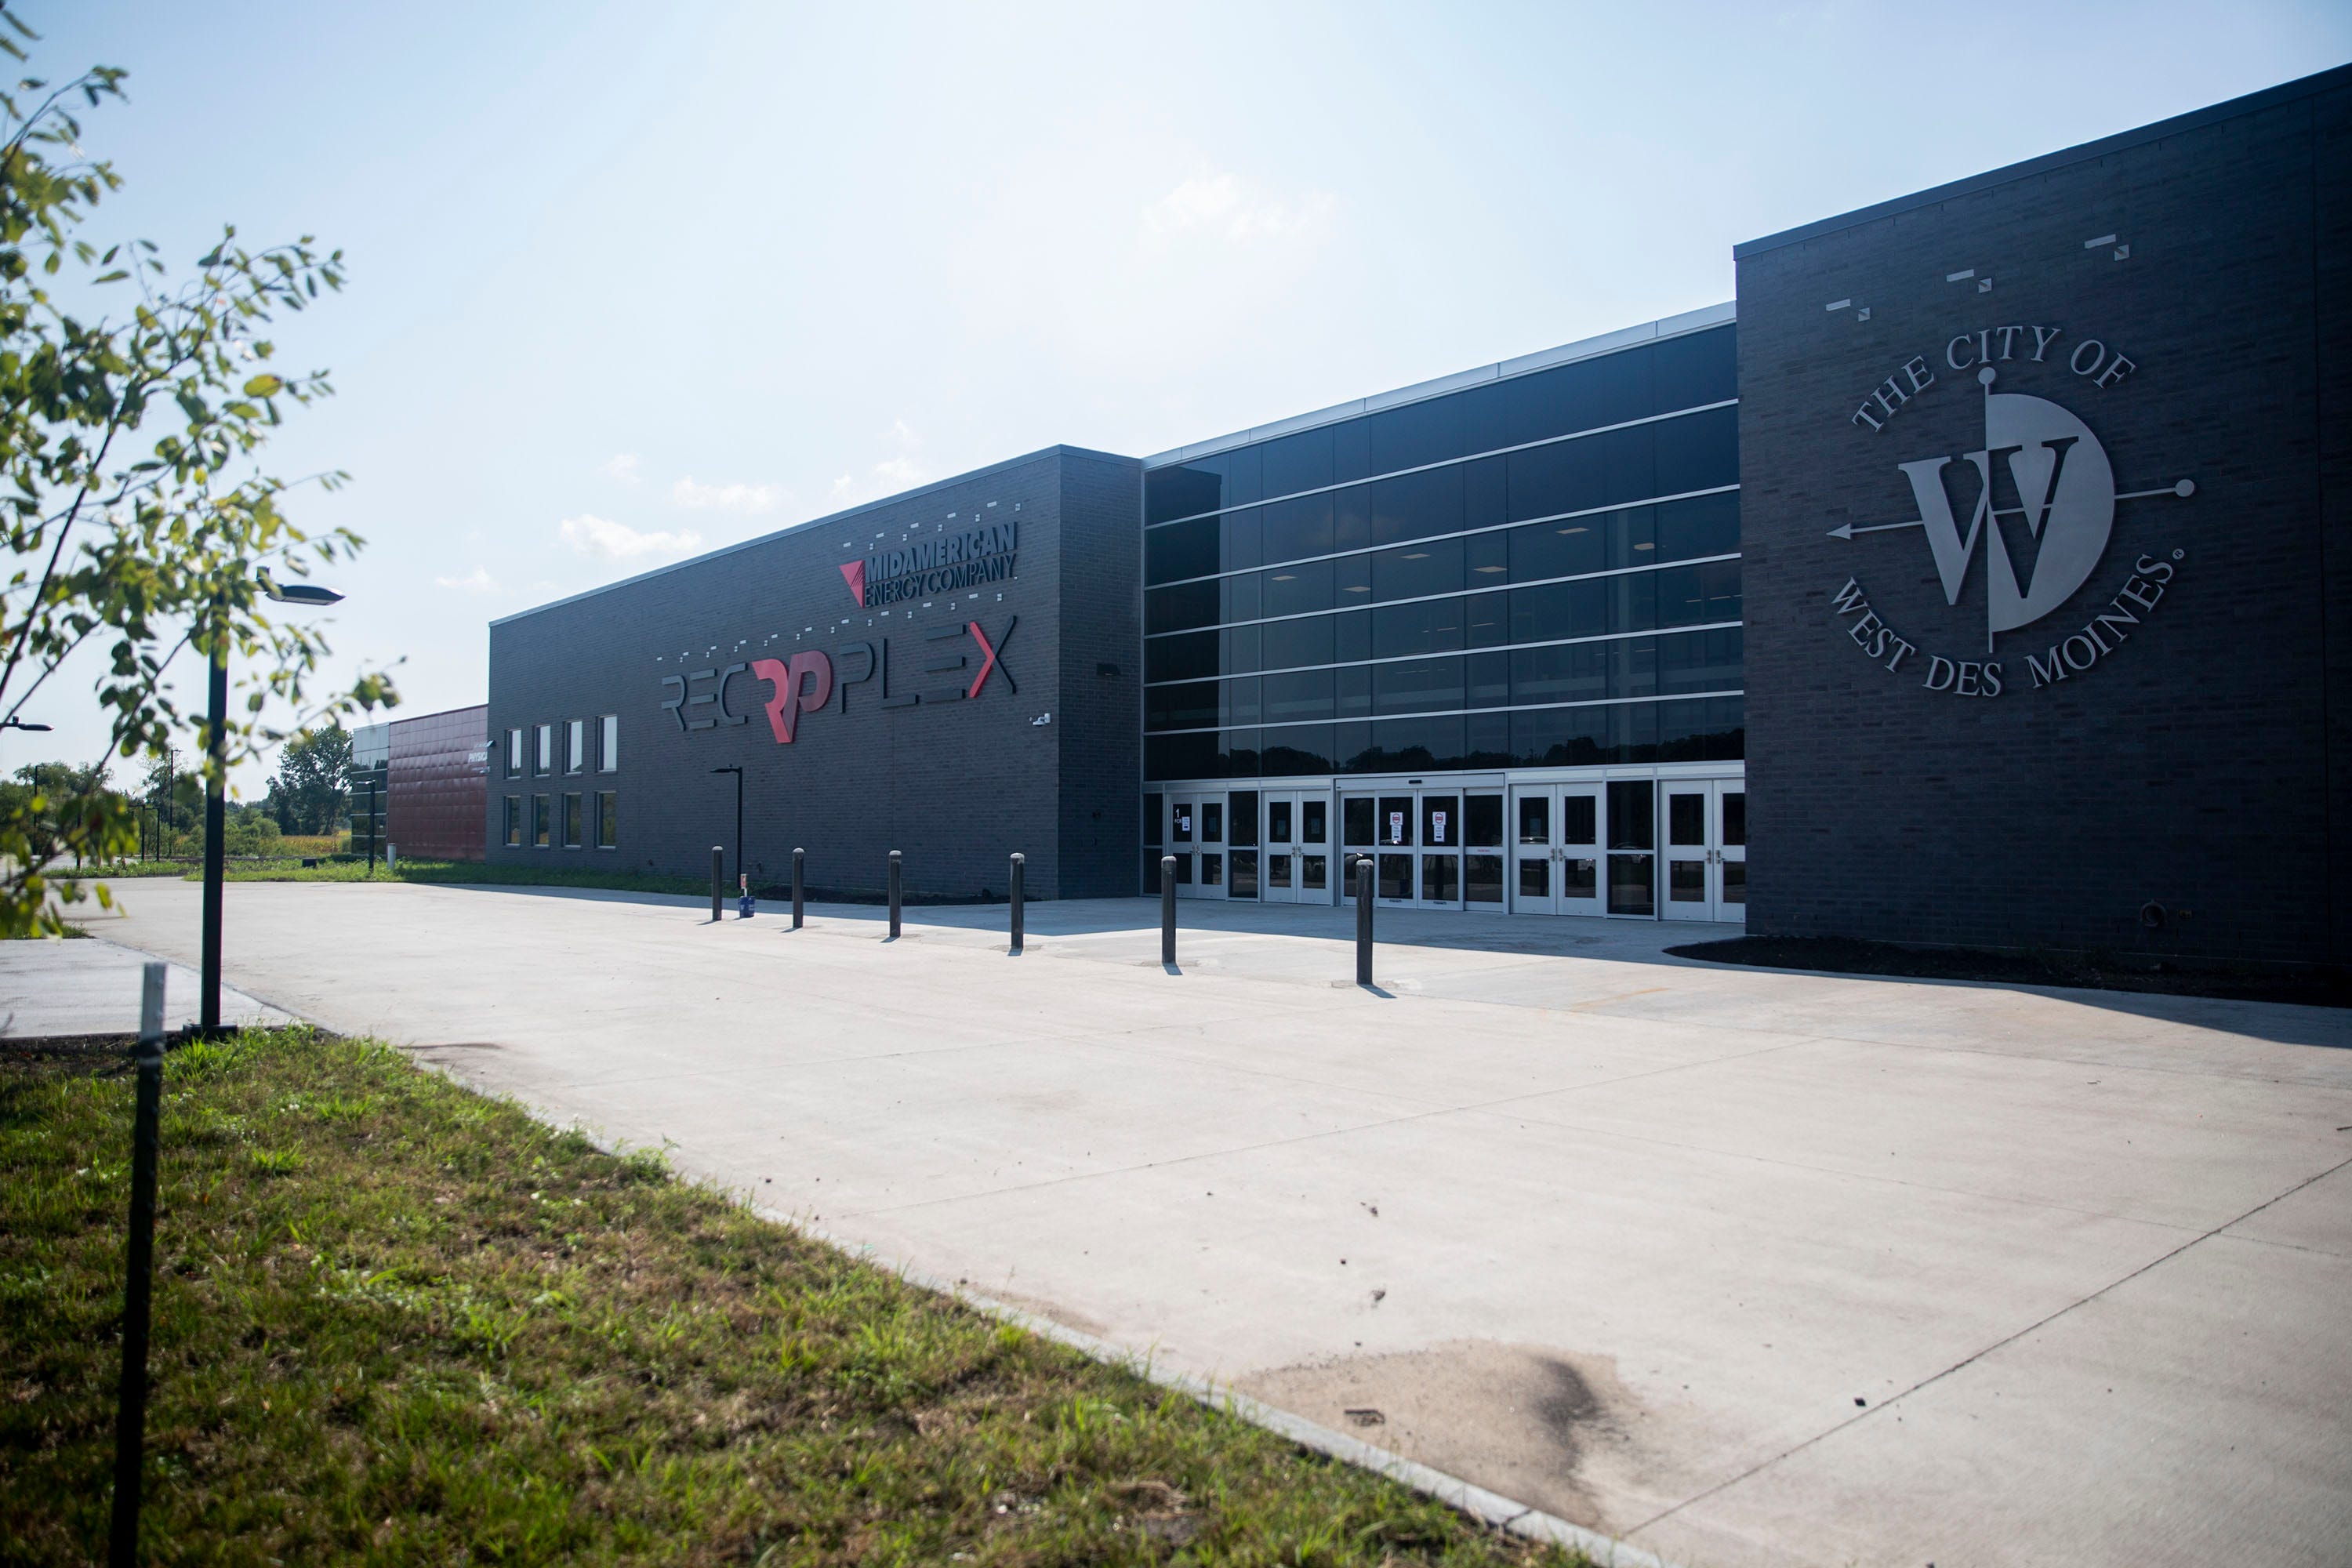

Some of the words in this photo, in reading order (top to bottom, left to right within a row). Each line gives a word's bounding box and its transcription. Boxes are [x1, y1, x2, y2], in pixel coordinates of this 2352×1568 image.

[1852, 355, 1936, 432] THE
[1947, 325, 2061, 370] CITY
[2071, 339, 2136, 389] OF
[865, 522, 1018, 583] MIDAMERICAN
[865, 573, 926, 608] ENERGY
[927, 553, 1017, 593] COMPANY
[1831, 577, 1917, 673] WEST
[1922, 655, 2002, 697] DES
